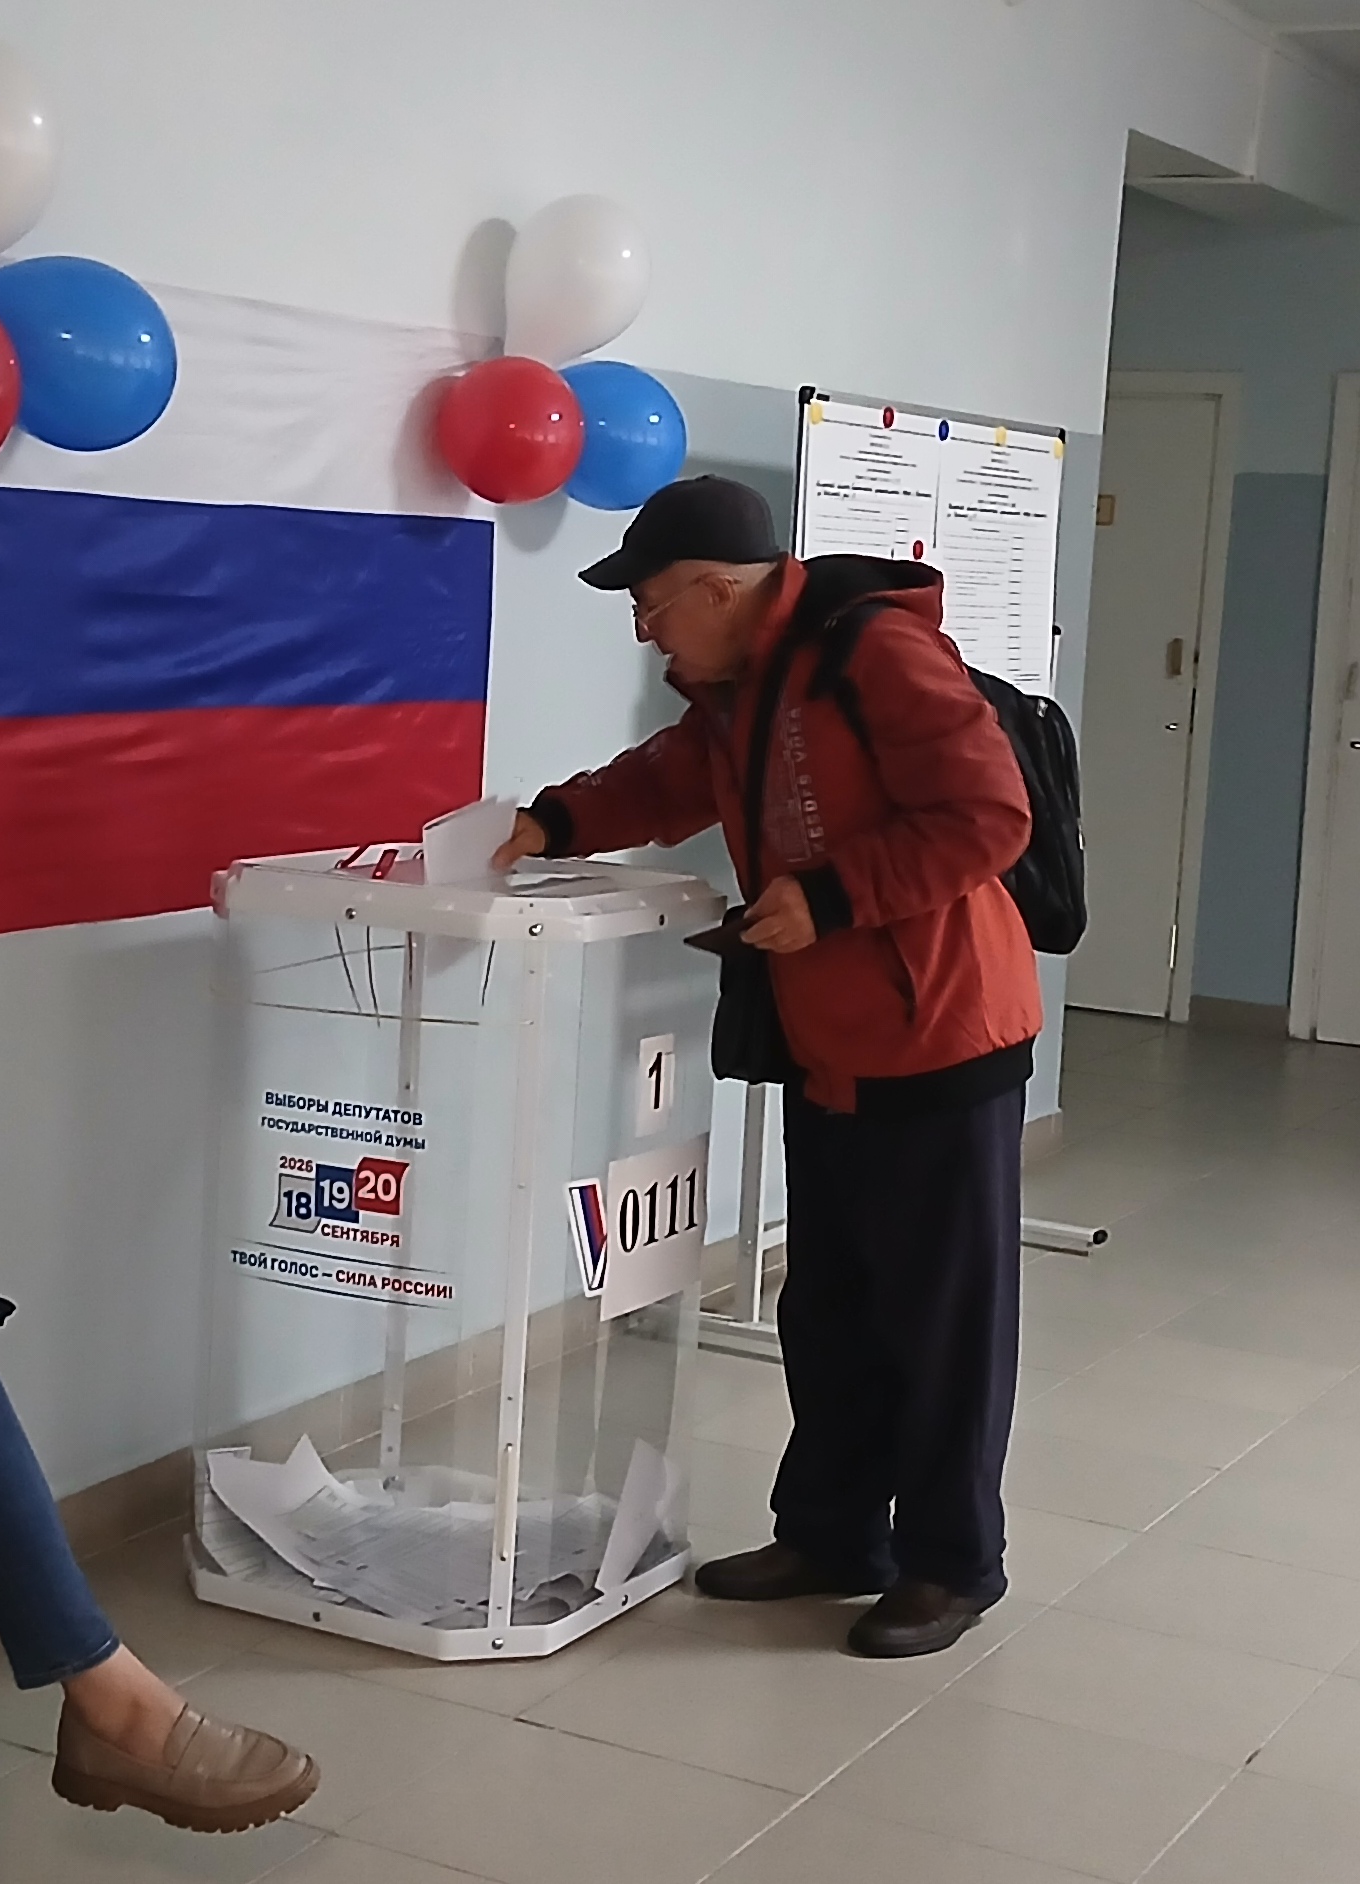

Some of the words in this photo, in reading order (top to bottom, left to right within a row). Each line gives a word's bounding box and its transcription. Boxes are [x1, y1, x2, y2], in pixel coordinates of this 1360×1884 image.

[648, 1052, 662, 1109] 1
[265, 1092, 329, 1113] ВЫБОРЫ
[332, 1102, 423, 1125] ДЕПУТАТОВ
[261, 1116, 383, 1145] ГОСУДАРСТВЕННОЙ
[385, 1133, 426, 1150] ДУМЫ
[279, 1156, 314, 1173] 2026
[283, 1190, 312, 1220] 18
[319, 1179, 350, 1210] 19
[358, 1170, 397, 1202] 20
[619, 1167, 698, 1253] 0111
[321, 1224, 400, 1248] СЕНТЯБРЯ
[231, 1250, 267, 1269] ТВОЙ
[271, 1259, 319, 1279] ГОЛОС
[335, 1269, 378, 1289] СИЛА
[381, 1277, 453, 1299] РОССИИ!
